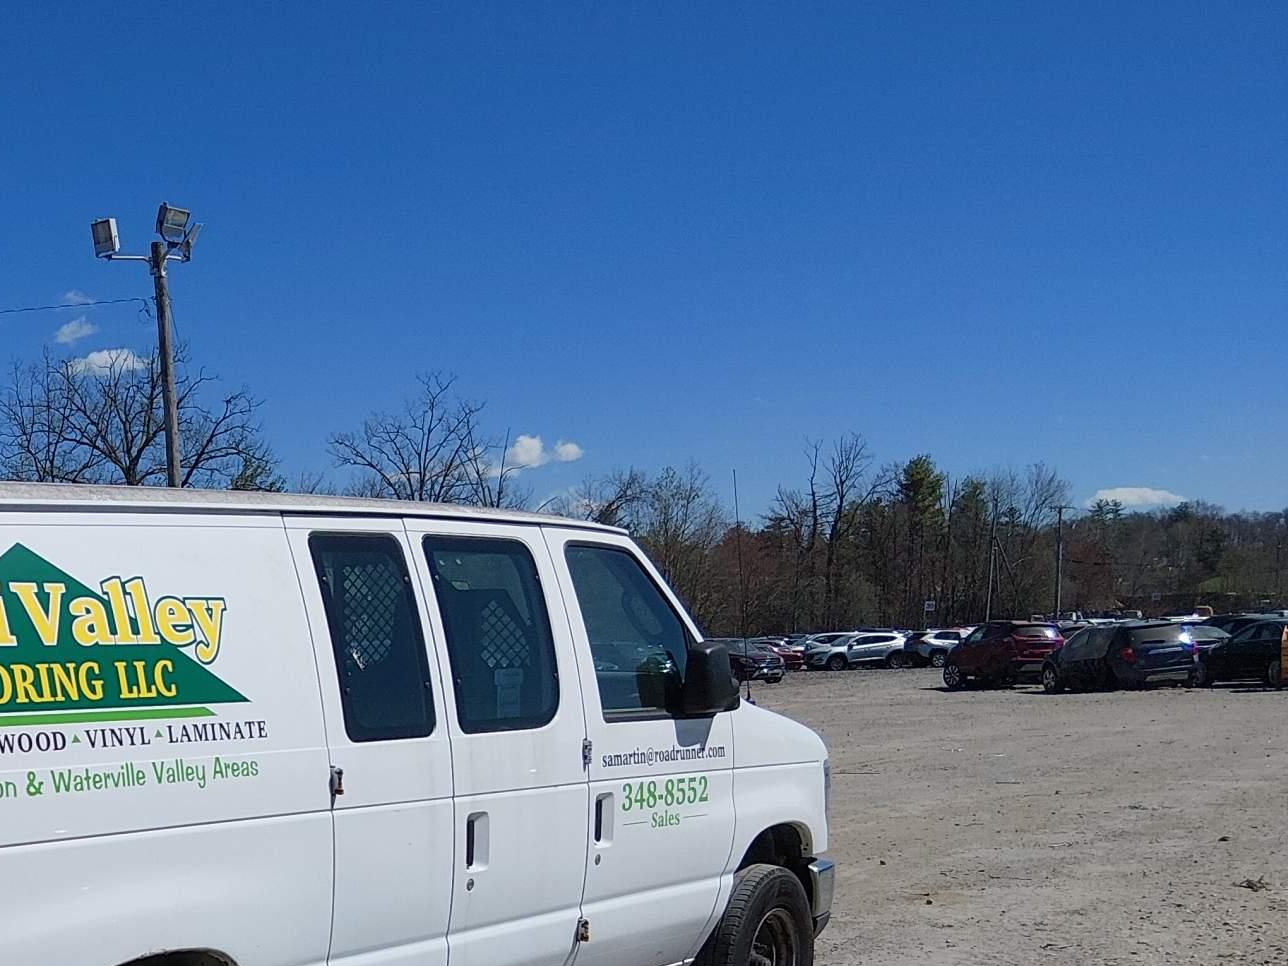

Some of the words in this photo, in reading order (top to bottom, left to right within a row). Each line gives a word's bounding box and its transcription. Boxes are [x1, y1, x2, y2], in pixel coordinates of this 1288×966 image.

[114, 660, 176, 699] LLC
[84, 726, 151, 748] VINYL
[166, 720, 268, 743] LAMINATE
[602, 745, 725, 768] samartin@roadrunner.com
[26, 771, 44, 796] &
[51, 762, 146, 794] Waterville
[152, 758, 206, 789] Valley
[213, 757, 259, 779] Areas
[622, 776, 709, 811] 348-8552
[651, 810, 680, 828] Sales
